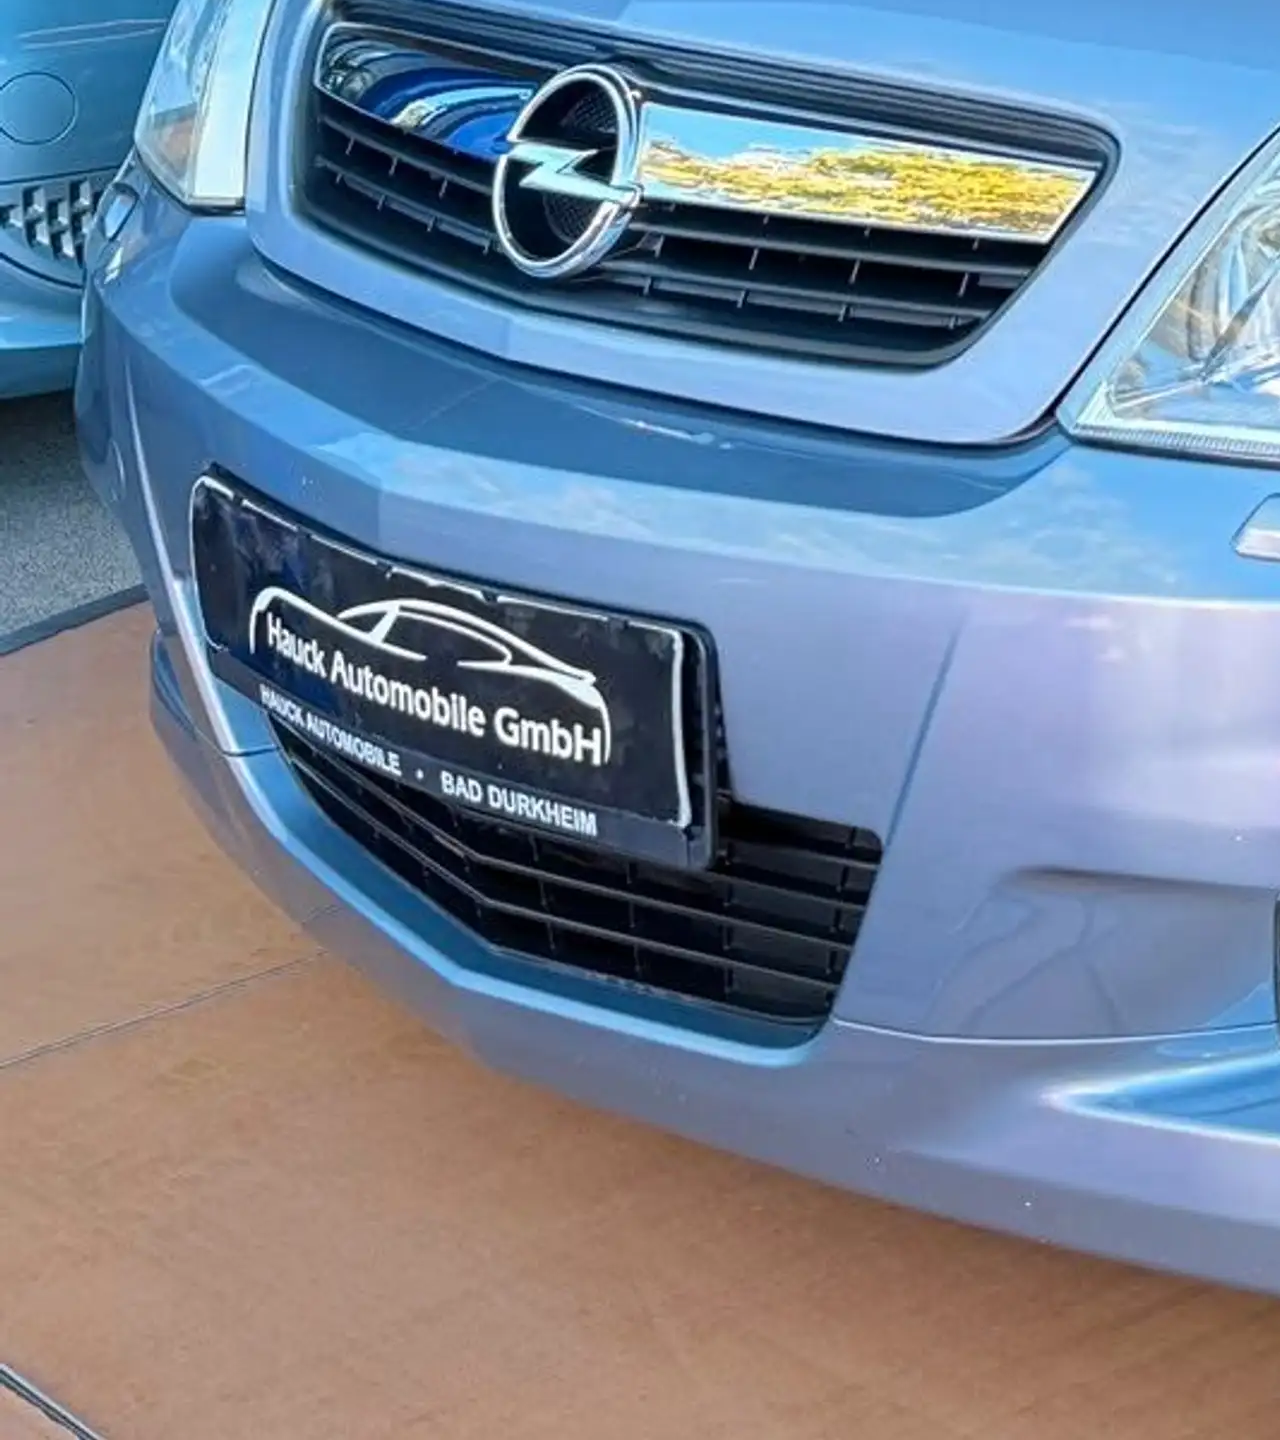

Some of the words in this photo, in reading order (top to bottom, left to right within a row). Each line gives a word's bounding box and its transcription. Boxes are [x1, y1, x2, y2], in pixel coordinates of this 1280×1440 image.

[259, 684, 304, 727] HAUCK
[306, 712, 402, 776] AUTOMOBILE
[440, 770, 483, 804] BAD
[487, 784, 597, 837] DURKHEIM
[267, 613, 326, 679] Hauck
[329, 650, 487, 738] Automobile
[494, 707, 602, 766] GmbH
